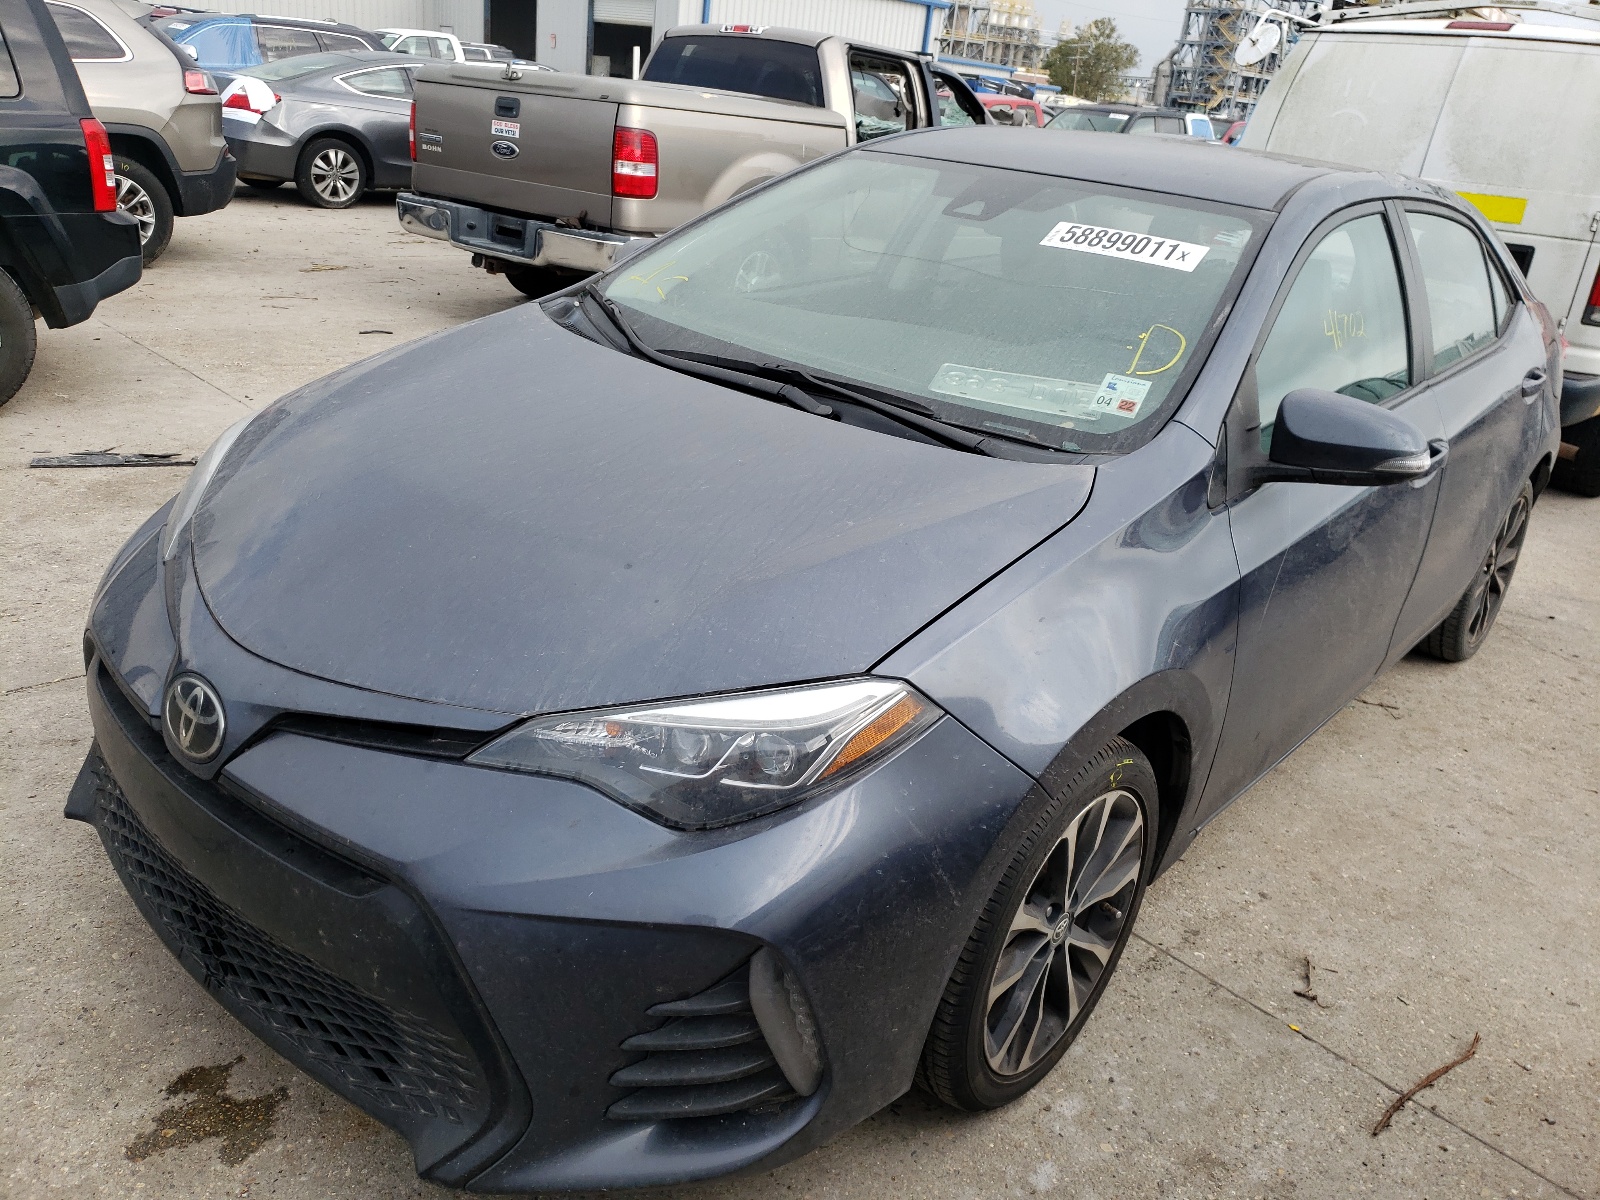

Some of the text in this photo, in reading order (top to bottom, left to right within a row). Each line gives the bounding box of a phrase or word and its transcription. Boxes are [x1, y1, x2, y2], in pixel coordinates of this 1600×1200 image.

[422, 143, 442, 153] BOHN
[1096, 395, 1136, 412] 04 22
